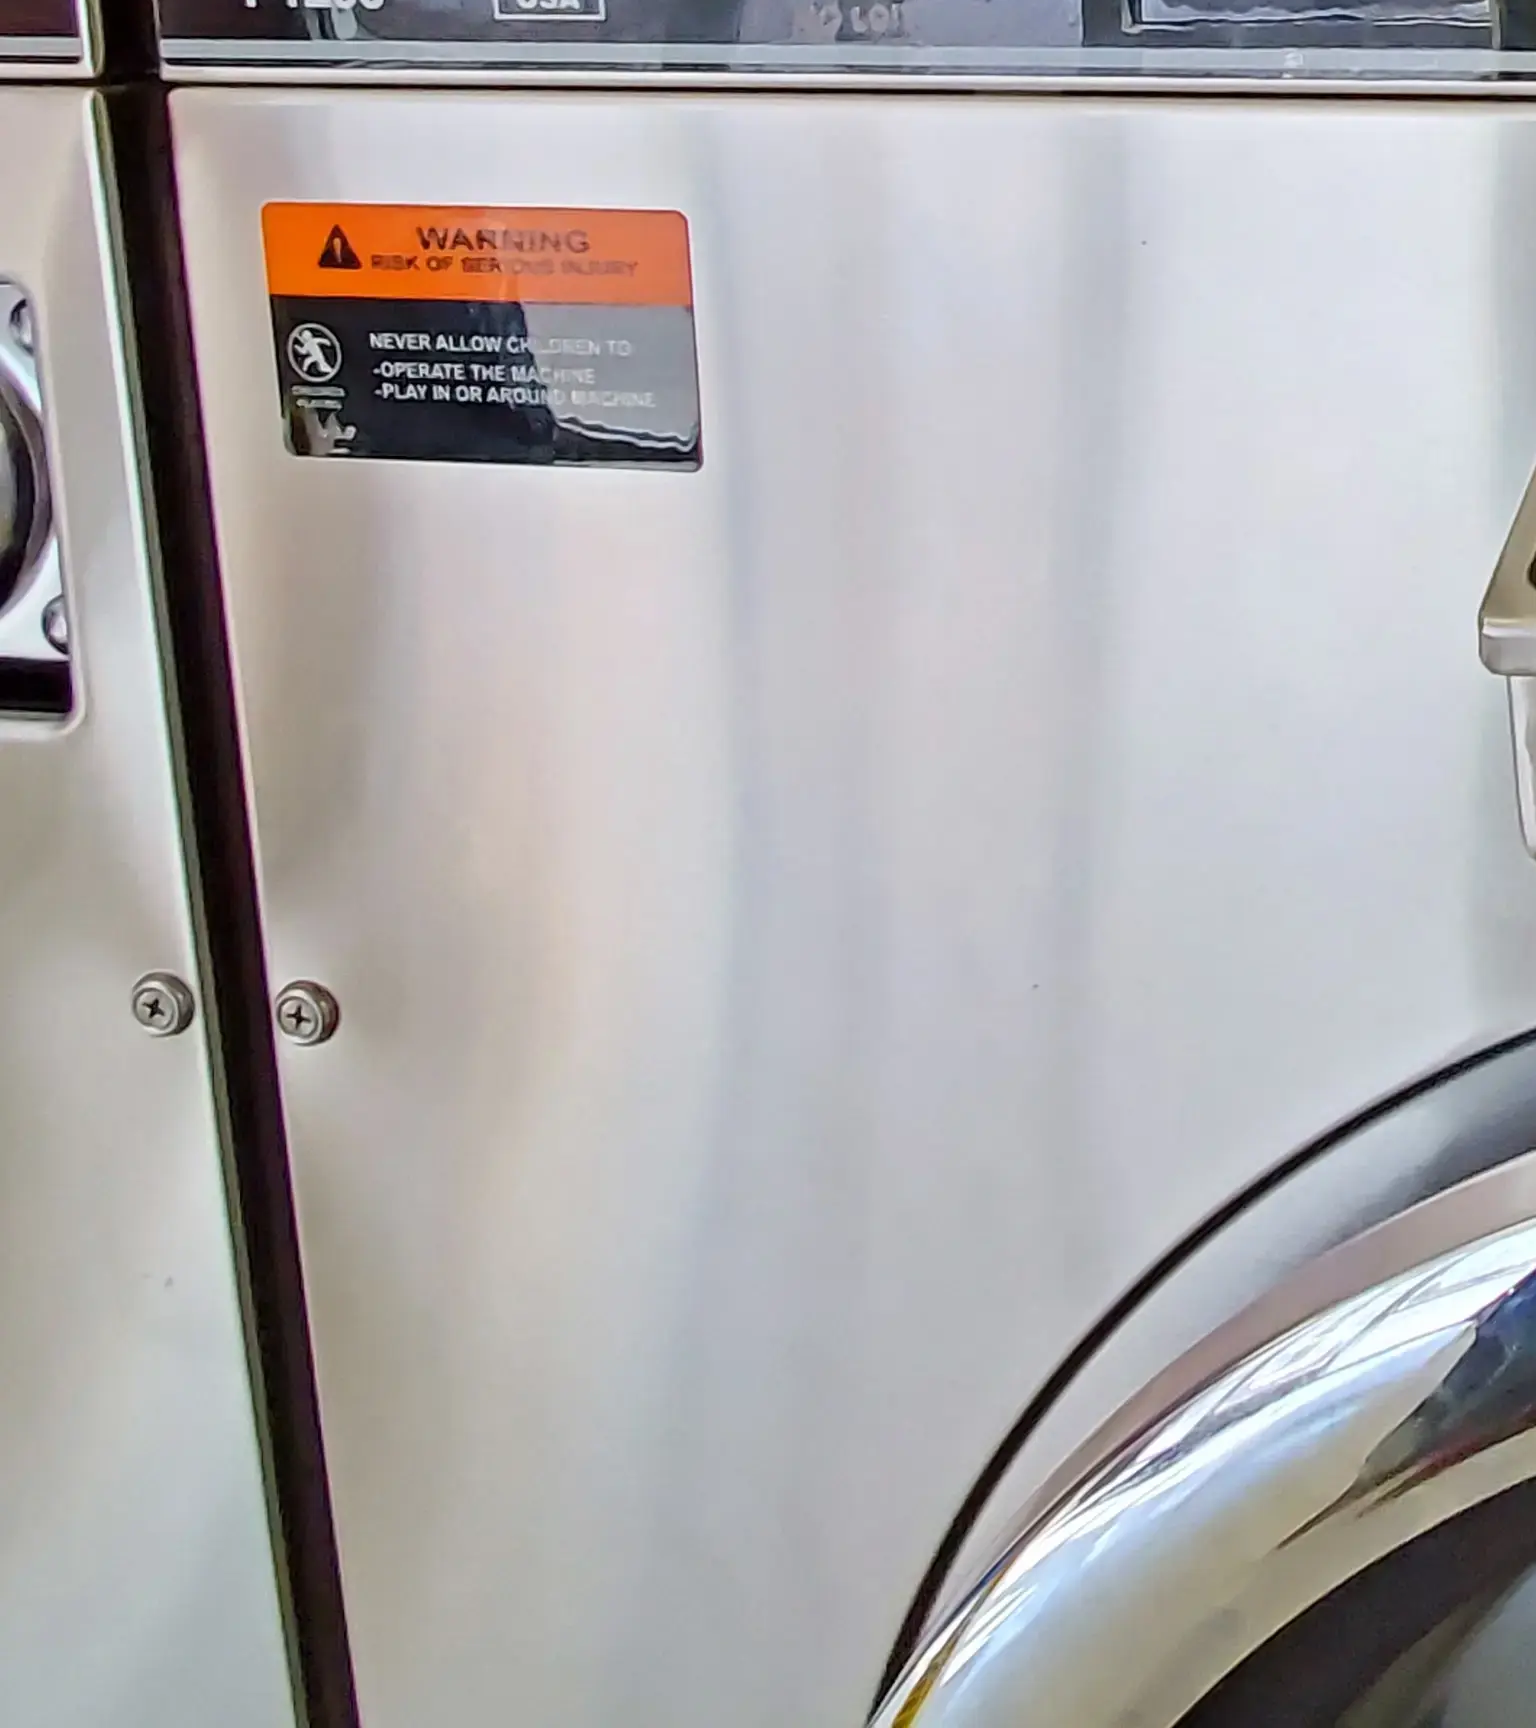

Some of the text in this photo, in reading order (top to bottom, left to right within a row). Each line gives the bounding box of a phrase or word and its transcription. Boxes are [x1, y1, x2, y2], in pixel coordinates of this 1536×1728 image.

[416, 226, 591, 254] WARNING
[371, 254, 421, 271] RISK
[426, 254, 454, 272] OF
[369, 332, 432, 351] NEVER
[435, 333, 503, 353] ALLOW
[470, 363, 506, 383] THE
[510, 364, 596, 386] MACHINE
[431, 384, 451, 402] IN
[455, 385, 483, 404] OR
[486, 386, 566, 409] AROUND
